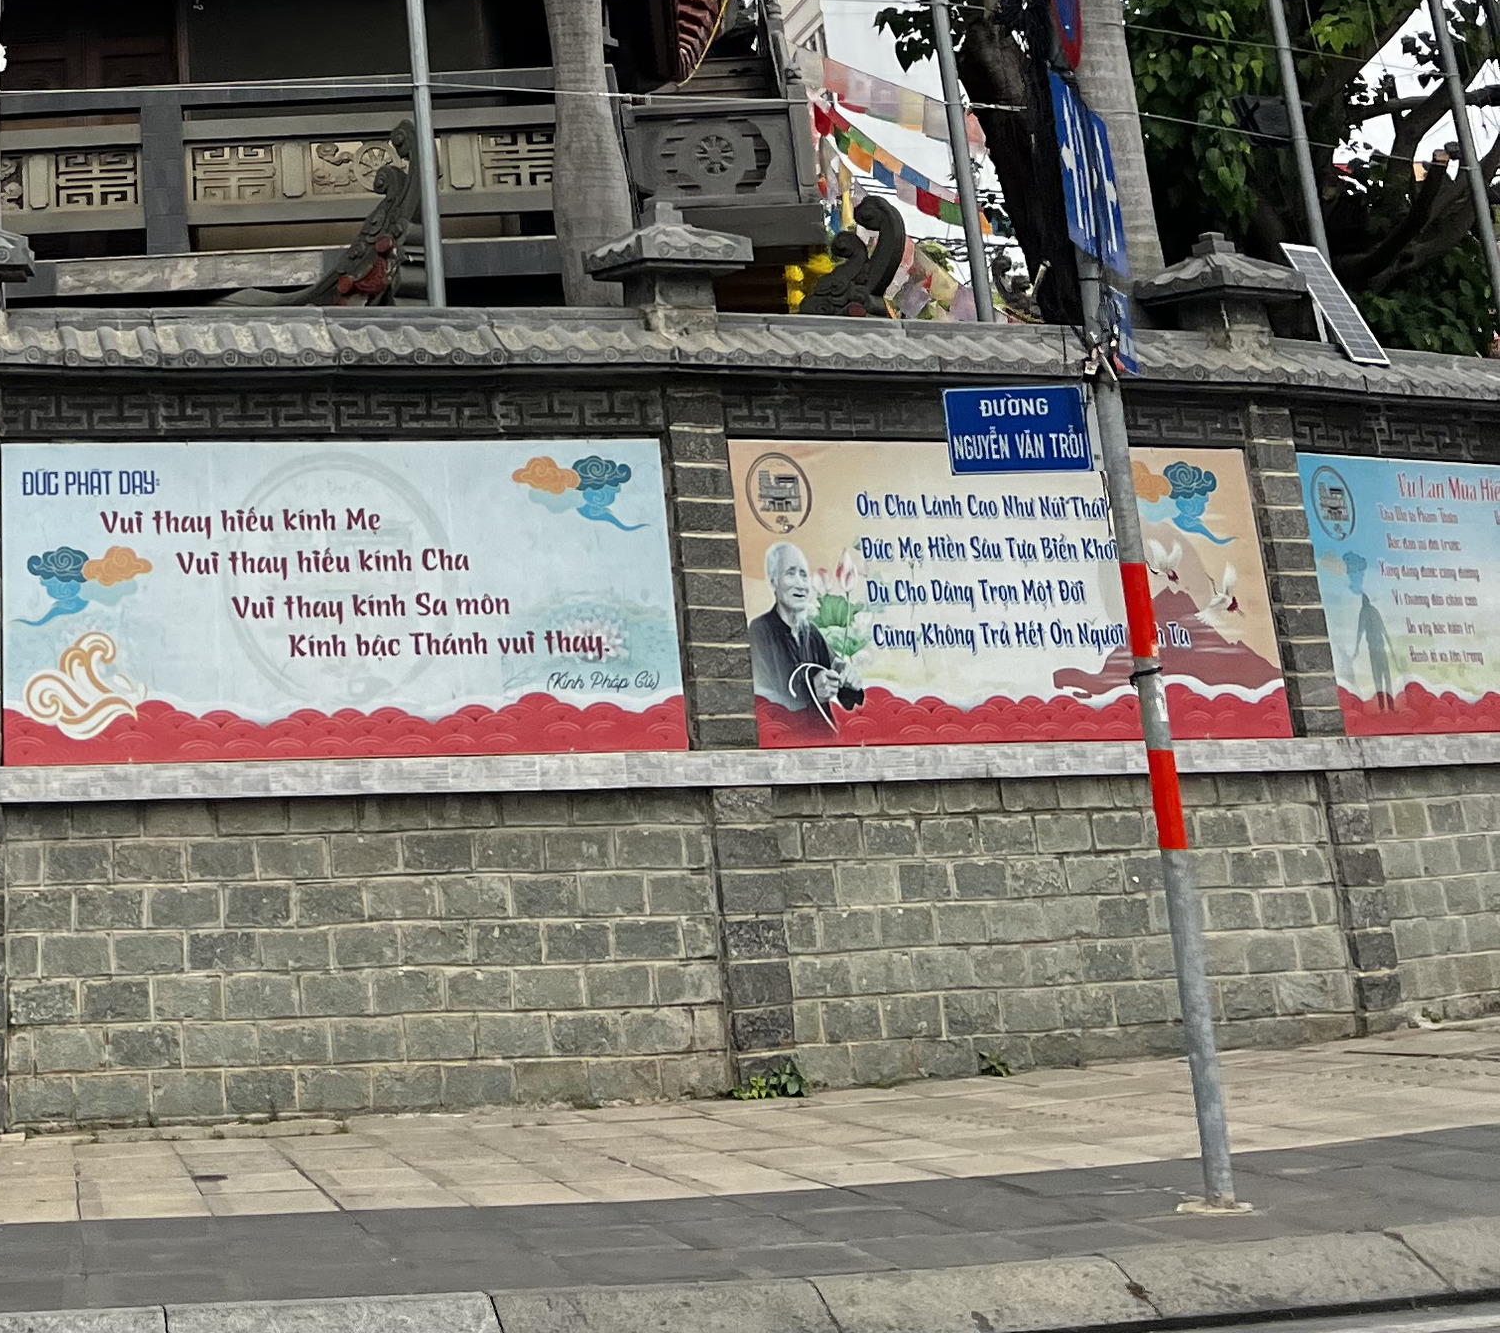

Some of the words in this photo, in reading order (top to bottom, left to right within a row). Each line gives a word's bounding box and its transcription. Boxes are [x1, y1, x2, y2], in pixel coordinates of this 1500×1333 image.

[979, 393, 1048, 417] ĐƯỜNG
[953, 425, 1011, 460] NGUYỄN
[1015, 429, 1045, 459] VĂN
[1050, 424, 1085, 459] TRỖI
[22, 469, 59, 496] ĐỨC
[65, 469, 112, 497] PHẬT
[120, 470, 160, 497] DẠY:
[885, 494, 916, 516] Cha
[921, 493, 961, 516] Lành
[967, 495, 998, 517] Cao
[1002, 496, 1034, 518] Như
[1038, 496, 1067, 517] Núi
[1066, 497, 1106, 518] Thái
[100, 511, 143, 534] Vui
[152, 511, 212, 539] thay
[221, 507, 274, 532] hiếu
[282, 508, 336, 531] kính
[347, 508, 381, 535] Mẹ
[176, 552, 219, 575] Vui
[229, 551, 288, 581] thay
[297, 547, 350, 573] hiếu
[359, 549, 412, 572] kính
[421, 548, 470, 571] Cha
[861, 538, 893, 560] Đức
[898, 538, 924, 562] Mẹ
[928, 534, 965, 560] Hiền
[970, 536, 1001, 560] Sâu
[1004, 537, 1037, 565] Tựa
[1040, 533, 1077, 560] Biển
[1081, 537, 1118, 560] Khơi
[232, 595, 274, 619] Vui
[284, 595, 343, 625] thay
[352, 594, 406, 617] kính
[415, 592, 447, 616] Sa
[456, 593, 510, 617] môn
[867, 581, 890, 603] Dù
[895, 581, 926, 604] Cho
[932, 579, 975, 610] Dâng
[978, 579, 1018, 609] Trọn
[1023, 581, 1055, 612] Một
[1058, 580, 1086, 603] Đời
[289, 634, 346, 657] Kính
[356, 634, 400, 661] bậc
[409, 632, 488, 656] Thánh
[498, 630, 534, 654] vui
[544, 630, 610, 660] thay.
[872, 624, 916, 654] Cũng
[922, 623, 976, 653] Không
[980, 622, 1010, 647] Trả
[1015, 622, 1045, 651] Hết
[1077, 623, 1125, 653] Người
[1167, 623, 1190, 646] Ta
[590, 671, 630, 692] Pháp
